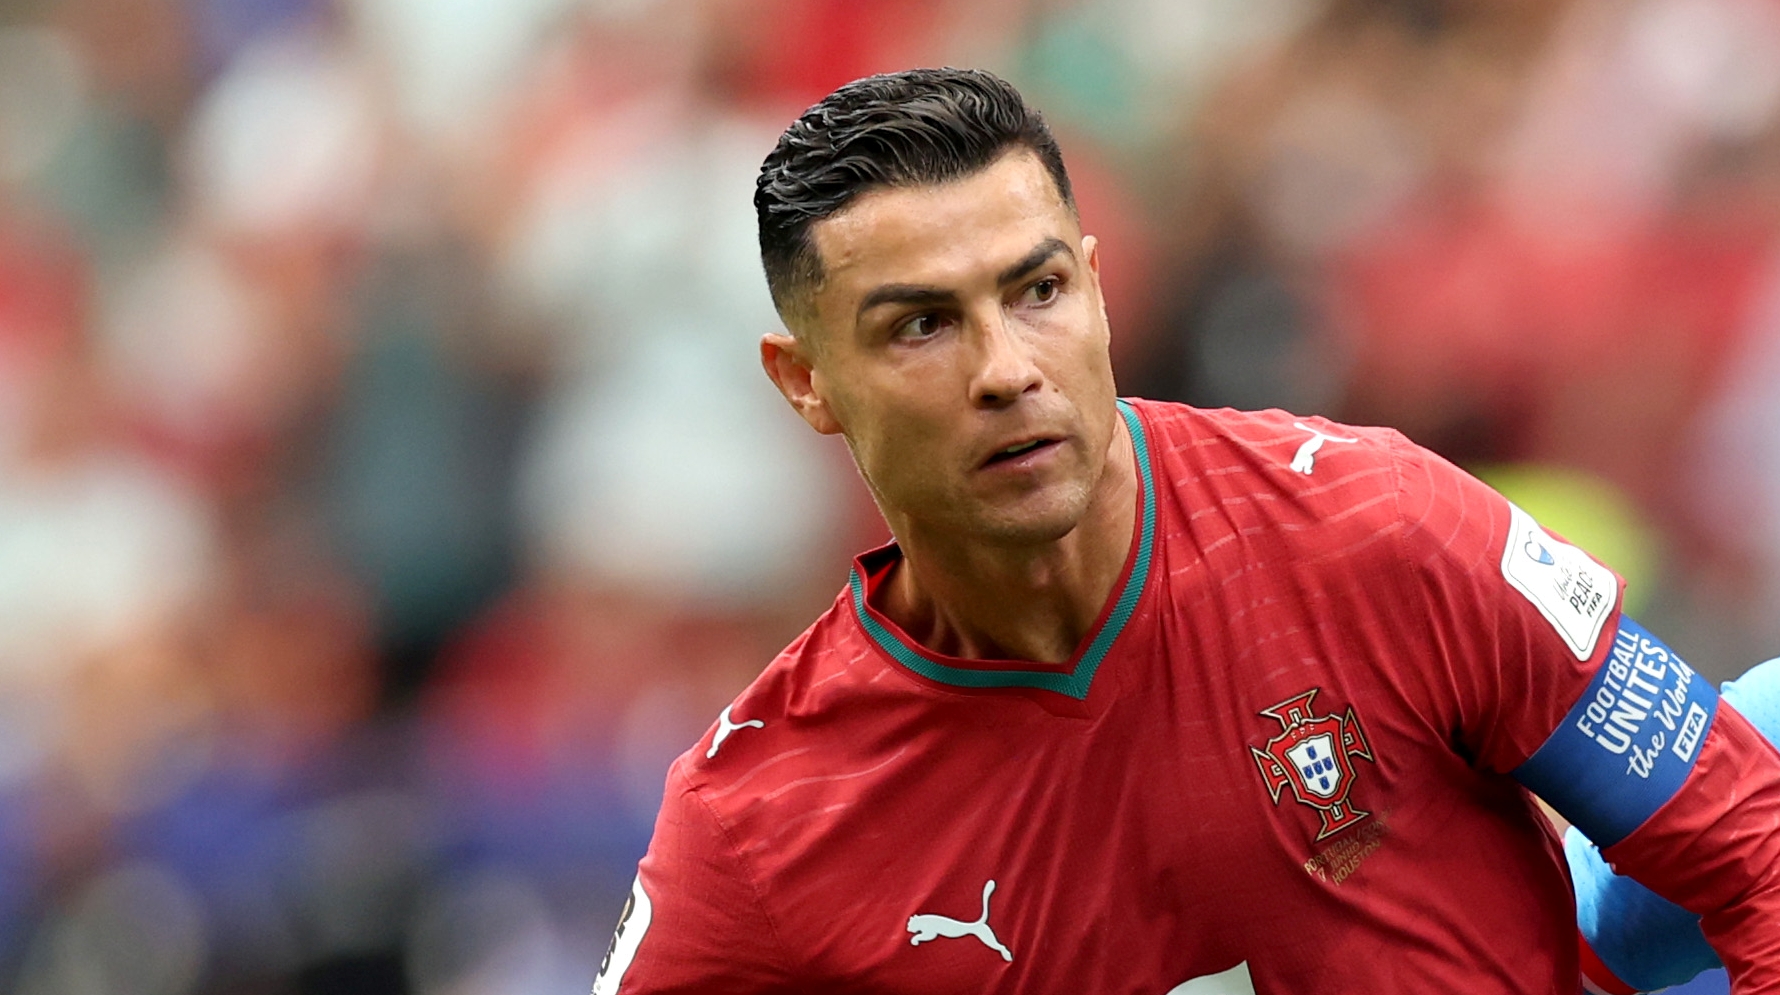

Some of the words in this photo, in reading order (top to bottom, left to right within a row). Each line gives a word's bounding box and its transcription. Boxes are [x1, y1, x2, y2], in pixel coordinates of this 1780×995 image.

[1586, 592, 1603, 618] FIFA
[1576, 629, 1639, 739] FOOTBALL
[1595, 638, 1668, 754] UNITES
[1626, 731, 1665, 778] the
[1653, 652, 1696, 731] World
[1675, 707, 1702, 759] FIFA
[1332, 838, 1381, 886] HOUSTON
